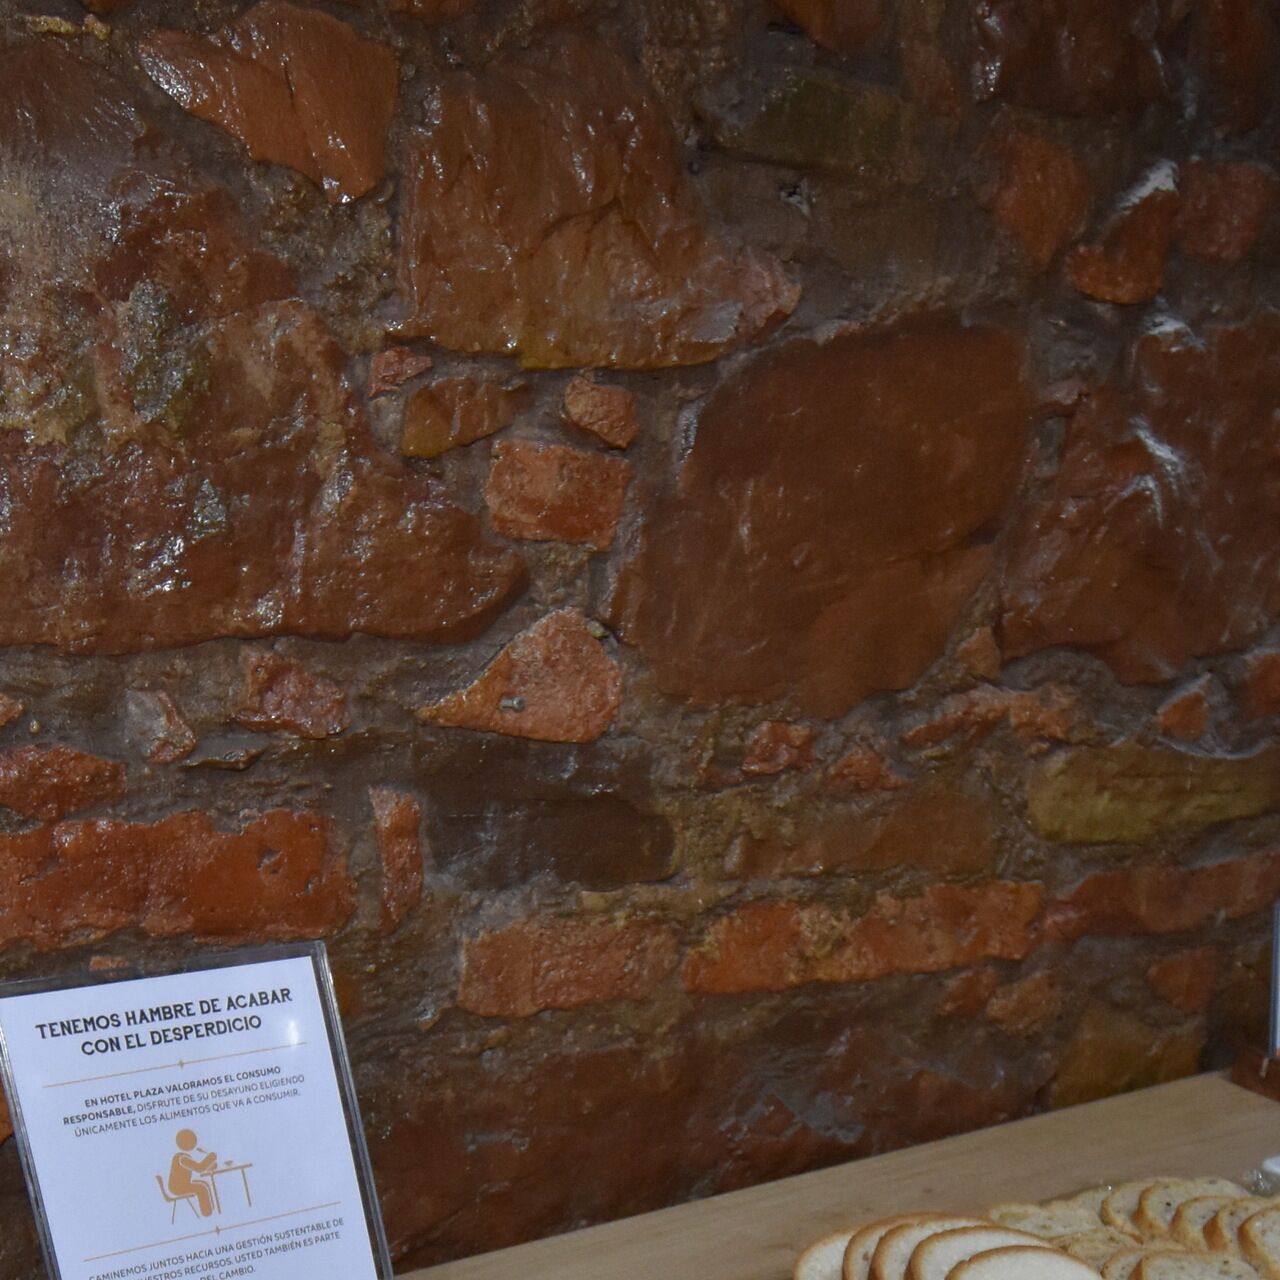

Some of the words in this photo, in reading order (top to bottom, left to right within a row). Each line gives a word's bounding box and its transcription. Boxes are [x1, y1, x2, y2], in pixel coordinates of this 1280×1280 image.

[35, 1014, 122, 1040] TENEMOS
[125, 1002, 196, 1026] HAMBRE
[200, 998, 221, 1015] DE
[226, 987, 292, 1011] ACABAR
[80, 1037, 122, 1056] CON
[126, 1033, 147, 1050] EL
[151, 1015, 262, 1046] DESPERDICIO
[63, 1105, 136, 1125] RESPONSABLE,
[137, 1097, 181, 1112] DISFRUTE
[183, 1095, 195, 1104] DE
[196, 1093, 209, 1101] SU
[210, 1083, 258, 1099] DESAYUNO
[260, 1074, 304, 1090] ELIGIENDO
[85, 1098, 98, 1108] EN
[100, 1092, 132, 1105] HOTEL
[133, 1088, 164, 1099] PLAZA
[165, 1076, 222, 1093] VALORAMOS
[224, 1074, 235, 1083] EL
[236, 1066, 281, 1080] CONSUMO
[74, 1117, 137, 1137] ÚNICAMENTE
[139, 1114, 157, 1125] LOS
[159, 1104, 211, 1122] ALIMENTOS
[213, 1101, 231, 1112] QUE
[232, 1099, 244, 1108] VA
[245, 1097, 253, 1105] A
[149, 1255, 184, 1271] JUNTOS
[186, 1249, 214, 1263] HACIA
[215, 1244, 235, 1256] UNA
[235, 1234, 273, 1251] GESTIÓN
[274, 1222, 331, 1241] SUSTENTABLE
[332, 1217, 344, 1228] DE
[184, 1257, 232, 1276] RECURSOS.
[235, 1249, 263, 1264] USTED
[264, 1238, 301, 1256] TAMBIÉN
[303, 1238, 313, 1246] ES
[315, 1231, 340, 1244] PARTE
[219, 1265, 256, 1280] CAMBIO.
